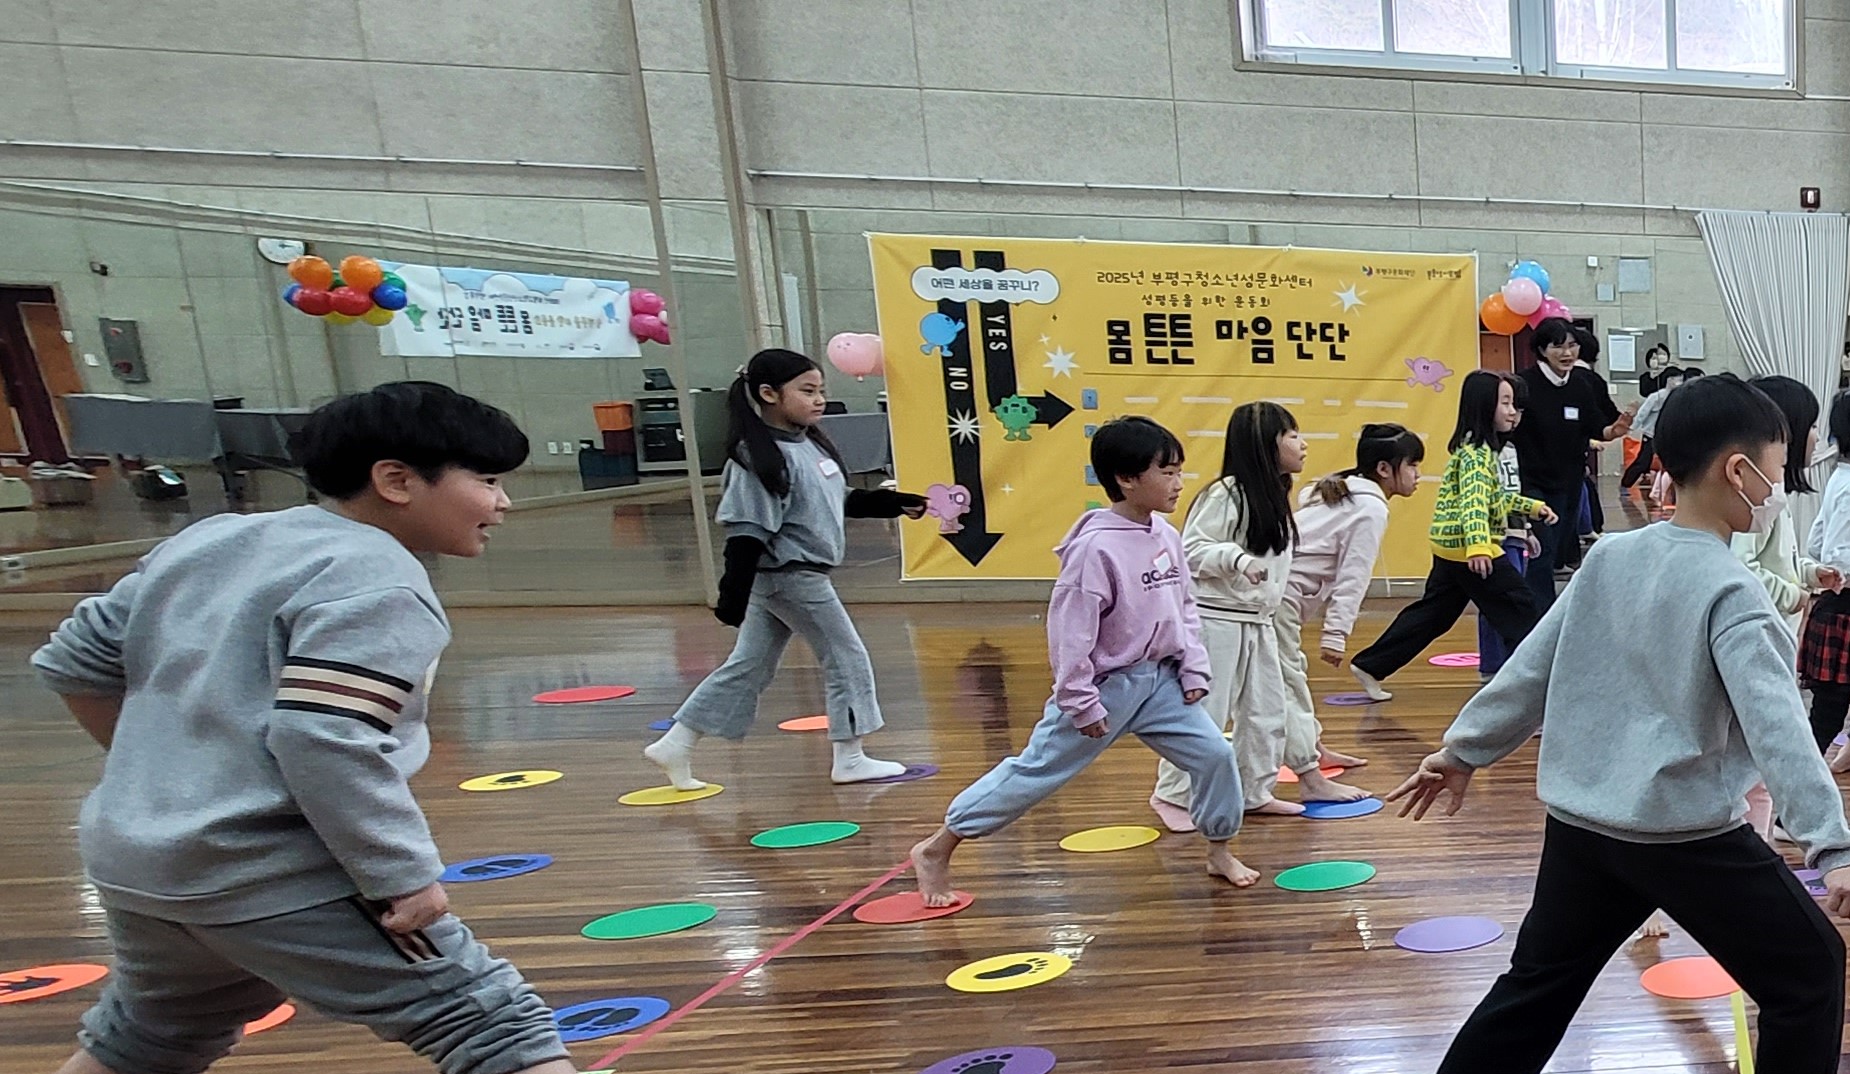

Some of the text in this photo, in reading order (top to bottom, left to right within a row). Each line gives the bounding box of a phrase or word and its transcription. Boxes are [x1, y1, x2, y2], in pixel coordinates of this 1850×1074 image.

[931, 278, 1040, 292] 어떤 세상을 꿈꾸니?
[1097, 270, 1313, 288] 2025년 부평구청소년성문화센터
[1141, 294, 1271, 308] 성평등을 위한 운동회
[986, 315, 1008, 351] YES
[1215, 316, 1274, 364] 마음
[1286, 321, 1350, 361] 단단
[948, 367, 969, 390] NO
